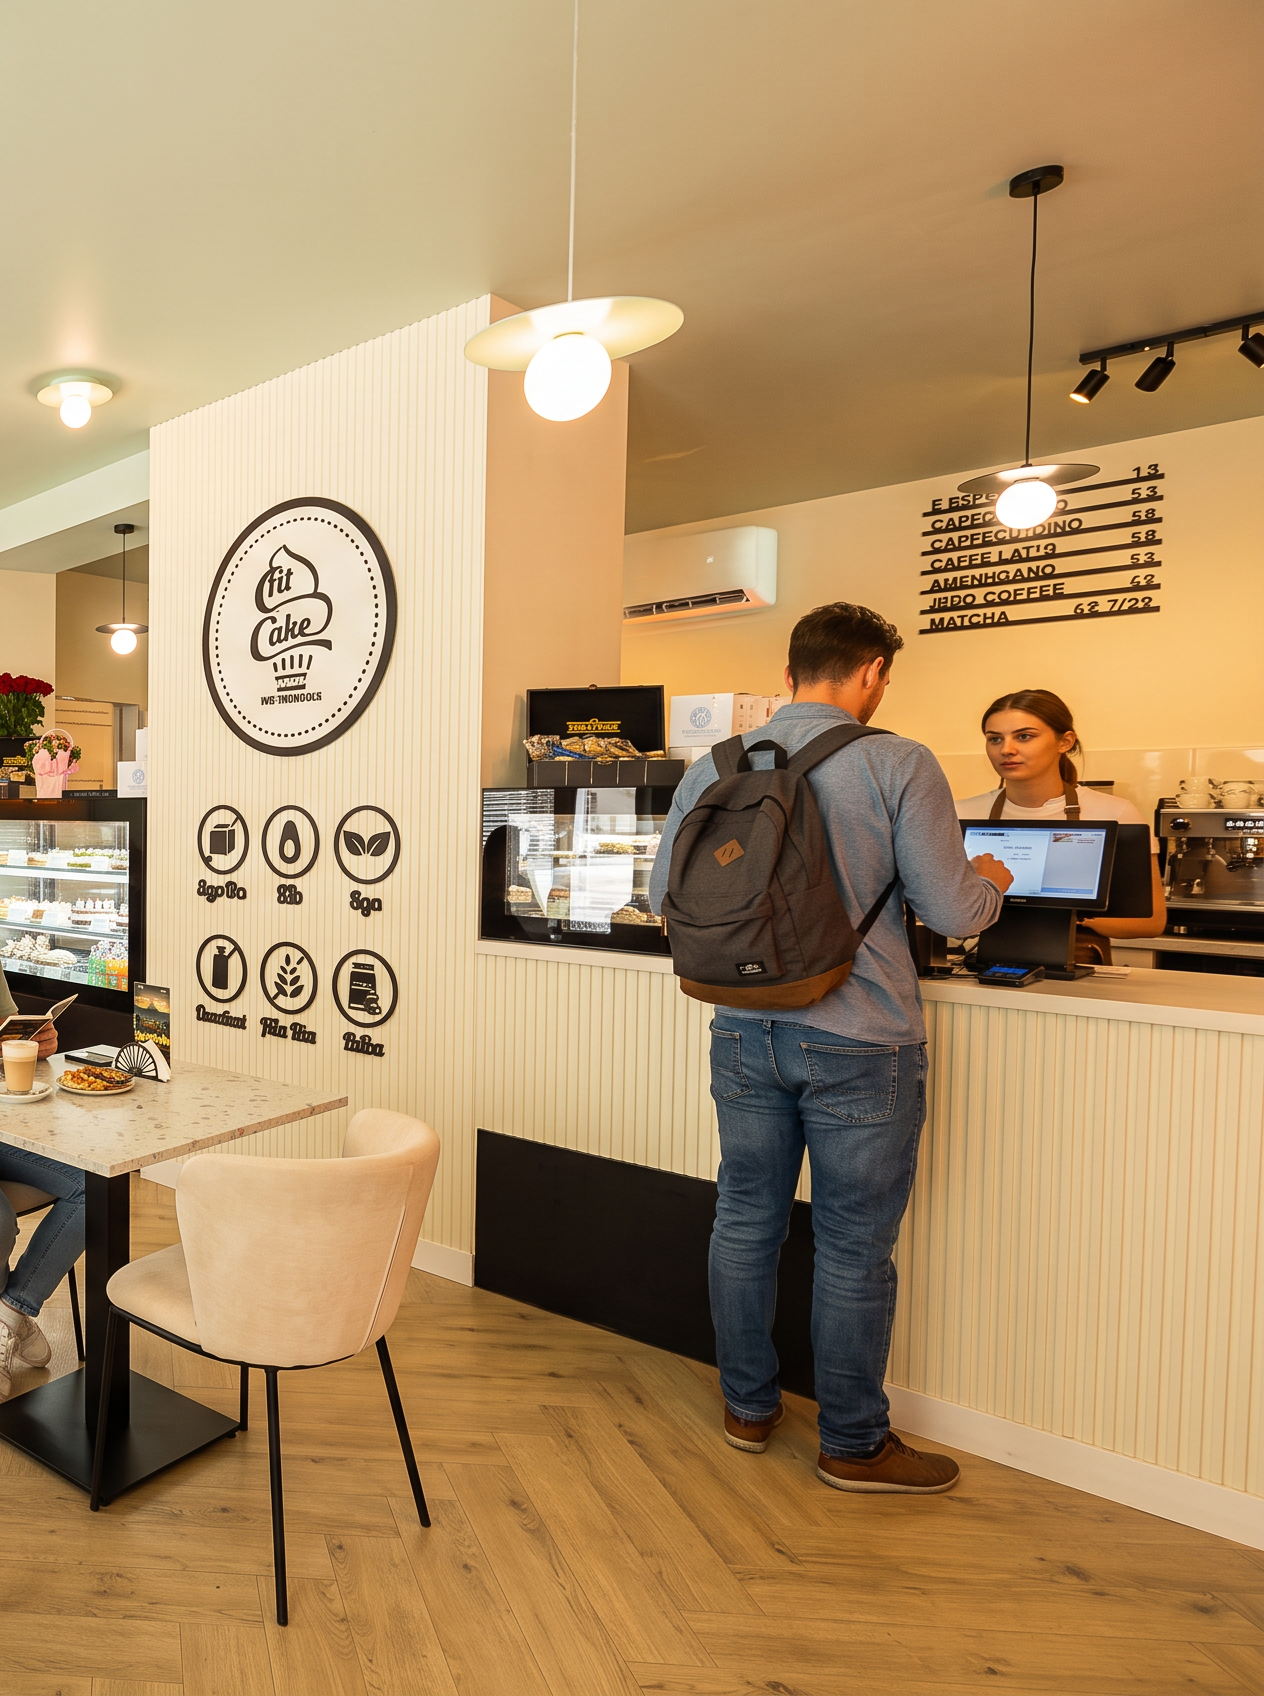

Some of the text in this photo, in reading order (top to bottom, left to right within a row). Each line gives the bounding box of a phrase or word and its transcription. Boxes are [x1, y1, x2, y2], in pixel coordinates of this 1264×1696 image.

[930, 552, 992, 571] CAFFE
[267, 566, 294, 598] fit
[983, 582, 1065, 604] COFFEE
[929, 611, 1010, 630] MATCHA
[250, 612, 313, 662] Cake
